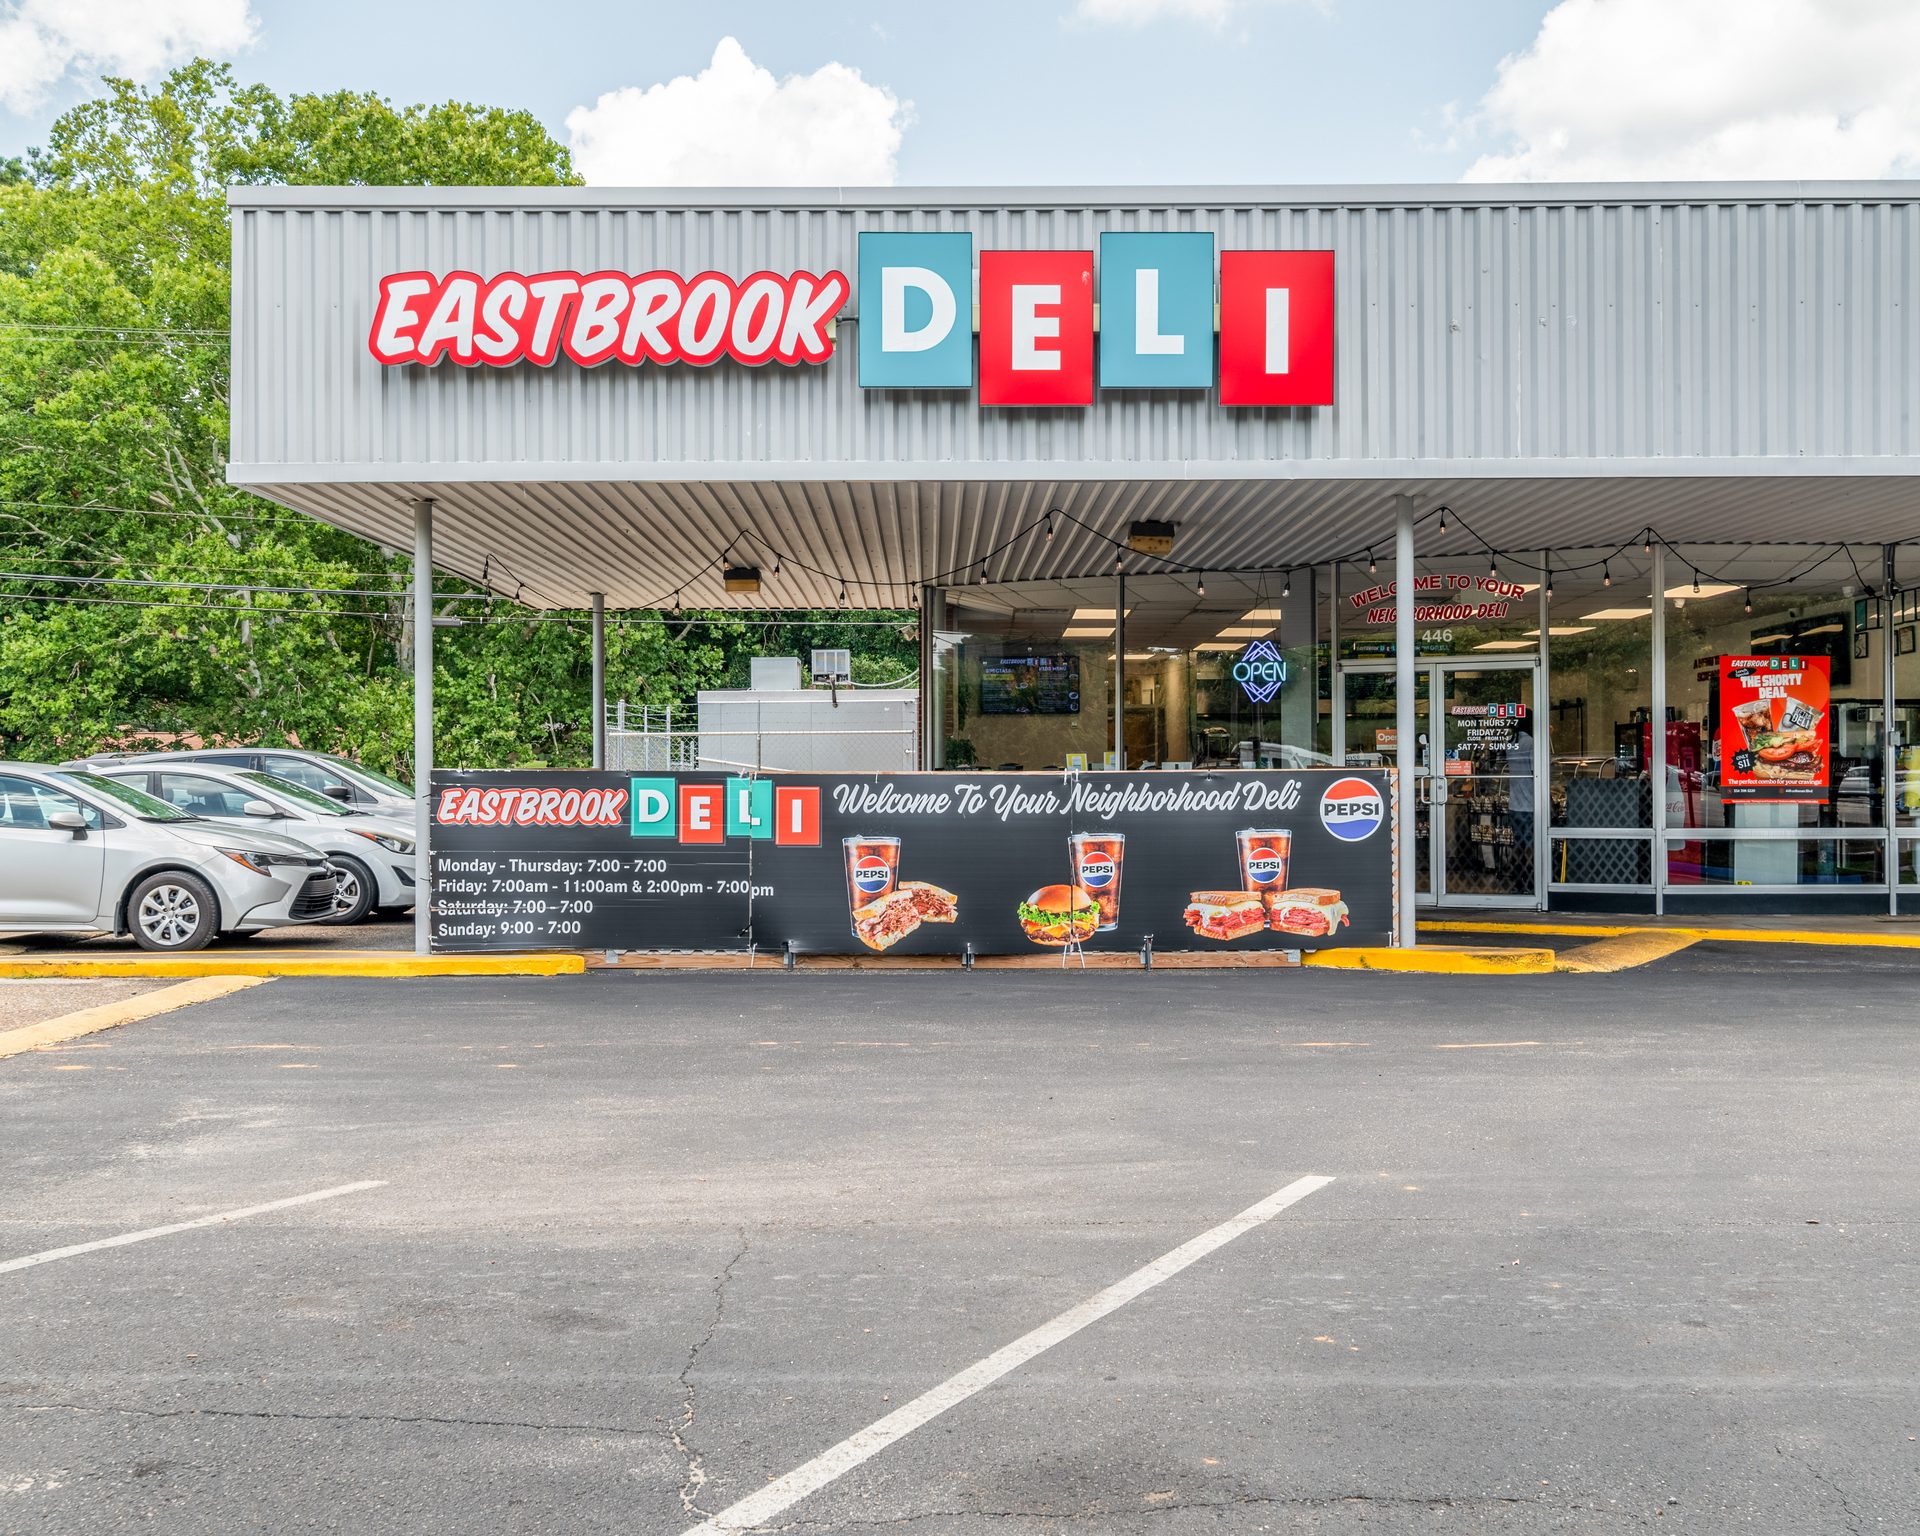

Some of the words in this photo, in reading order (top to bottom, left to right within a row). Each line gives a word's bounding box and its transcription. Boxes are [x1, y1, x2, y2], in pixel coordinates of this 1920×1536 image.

[374, 273, 847, 361] EASTBROOK
[882, 266, 1289, 375] DELI
[1351, 574, 1442, 608] WELCME
[1446, 575, 1471, 589] TO
[1475, 576, 1526, 600] YOUR
[1367, 604, 1474, 623] NEIGORHOOD
[1477, 602, 1509, 619] DELI
[1422, 629, 1453, 643] 446
[1233, 662, 1287, 681] OPEN
[1771, 659, 1806, 669] DELI
[1740, 675, 1761, 688] THE
[1762, 673, 1802, 687] SHORTY
[1759, 686, 1787, 699] DEAL
[1452, 706, 1487, 715] EASTBROOK
[1489, 705, 1522, 715] DELI
[1479, 719, 1505, 727] THURS
[833, 783, 951, 814] Welcome
[954, 784, 987, 814] To
[989, 784, 1061, 821] Your
[1059, 782, 1239, 820] Neighborhood
[1242, 780, 1302, 811] Deli
[438, 789, 627, 824] EASTBROOK
[638, 789, 803, 834] DELI
[1323, 803, 1380, 816] PEPSI
[438, 859, 496, 875] Monday
[509, 859, 583, 875] Thursday:
[587, 860, 620, 872] 7:00
[634, 860, 667, 872] 7:00
[1081, 865, 1114, 874] PEPSI
[1249, 861, 1280, 870] PEPSI
[856, 870, 888, 879] PEPSI
[438, 879, 487, 895] Friday:
[492, 880, 548, 892] 7:00am
[563, 880, 627, 893] 11:00am
[632, 880, 642, 893] &
[647, 880, 703, 896] 2:00pm
[438, 900, 508, 917] Saturday:
[513, 900, 546, 913] 7:00
[560, 900, 593, 913] 7:00
[438, 922, 496, 938] Sunday:
[500, 921, 534, 934] 9:00
[548, 921, 581, 934] 7:00
